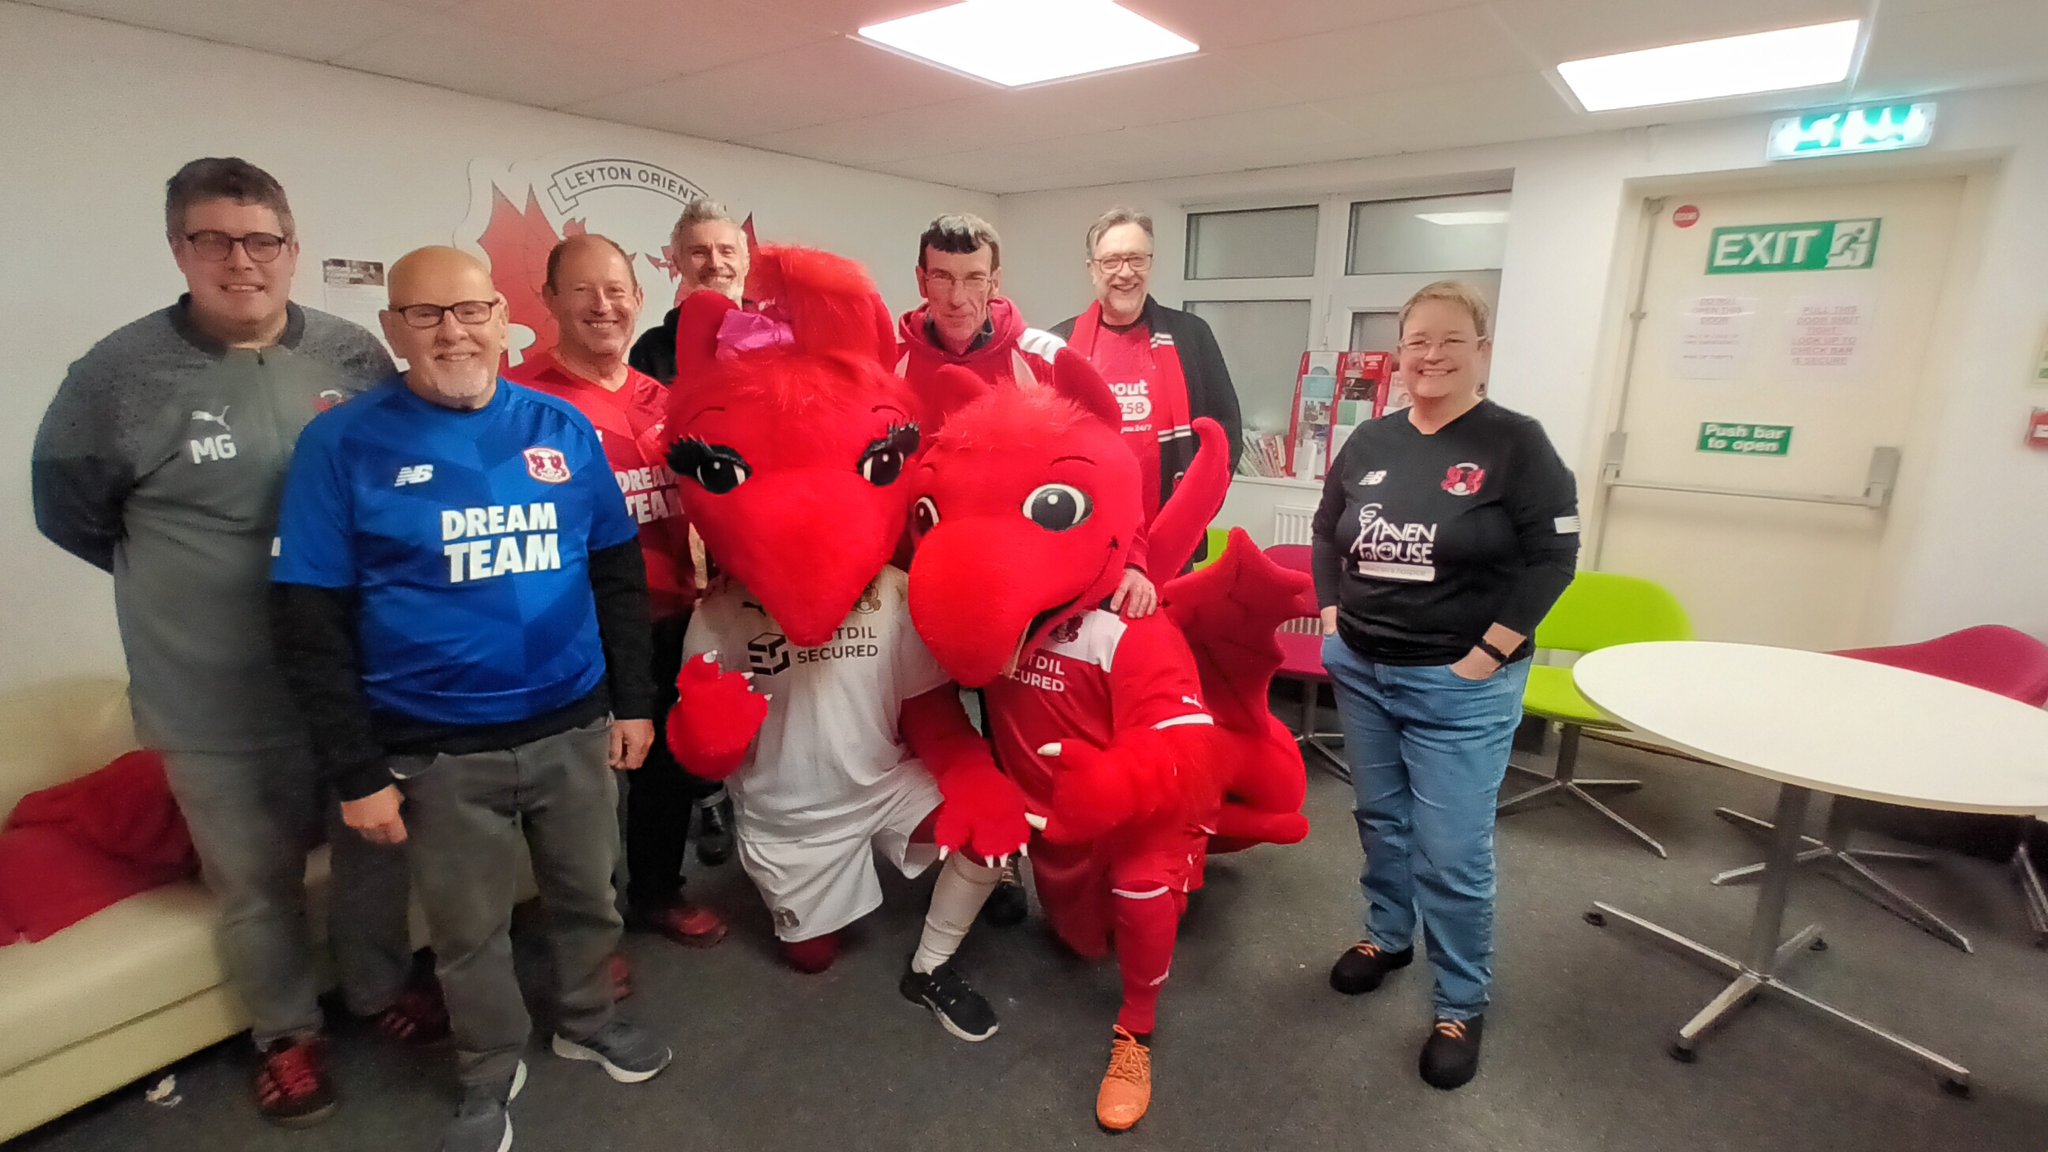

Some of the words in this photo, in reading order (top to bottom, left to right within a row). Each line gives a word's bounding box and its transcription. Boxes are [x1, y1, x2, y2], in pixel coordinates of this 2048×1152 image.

[565, 166, 632, 190] LEYTON
[637, 169, 698, 201] ORIENT
[1713, 229, 1821, 267] EXIT
[1705, 424, 1749, 437] Push
[1753, 427, 1786, 439] bar
[1708, 437, 1728, 449] to
[1732, 440, 1780, 453] open
[190, 433, 237, 464] MG
[441, 502, 558, 541] DREAM
[444, 533, 561, 583] TEAM
[797, 644, 878, 664] SECURED
